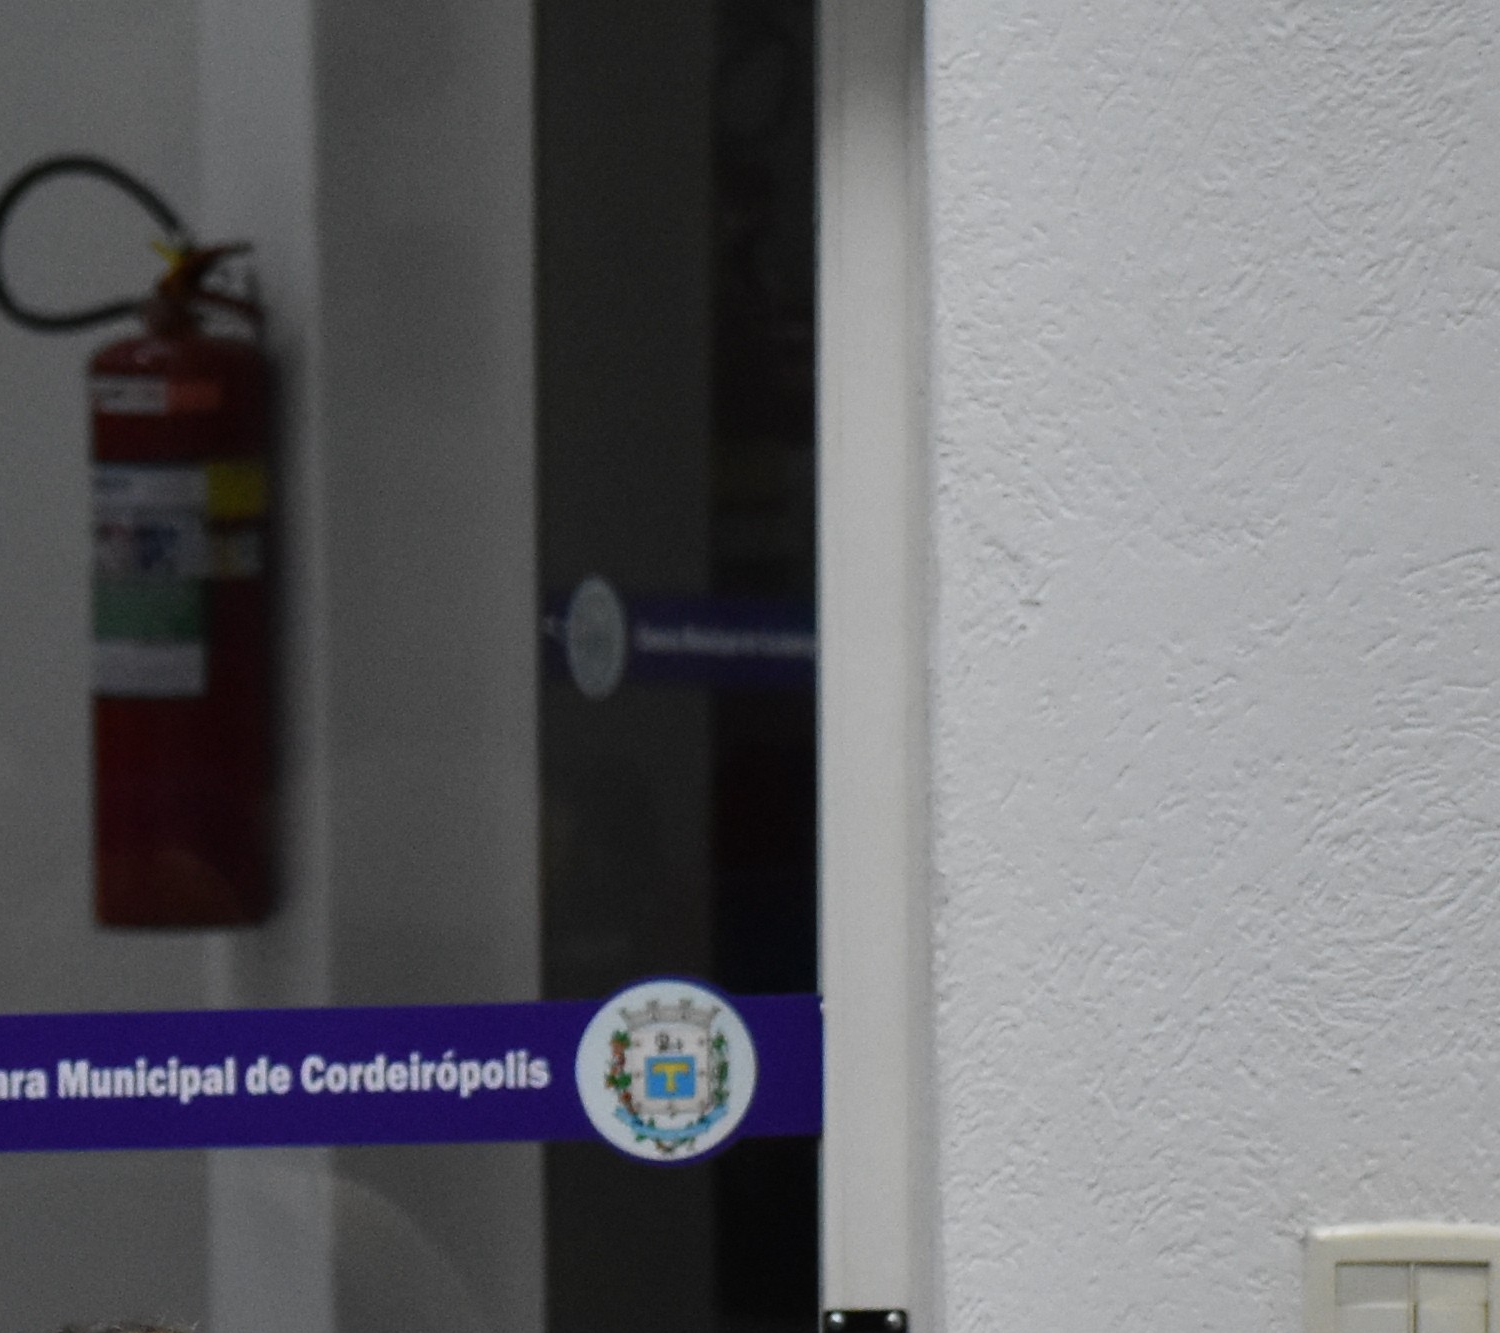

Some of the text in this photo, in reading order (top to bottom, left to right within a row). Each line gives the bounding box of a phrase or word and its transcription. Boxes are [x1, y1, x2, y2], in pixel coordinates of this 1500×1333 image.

[57, 1058, 237, 1104] Municipal
[246, 1054, 291, 1096] de
[301, 1050, 550, 1096] Cordeirópolis
